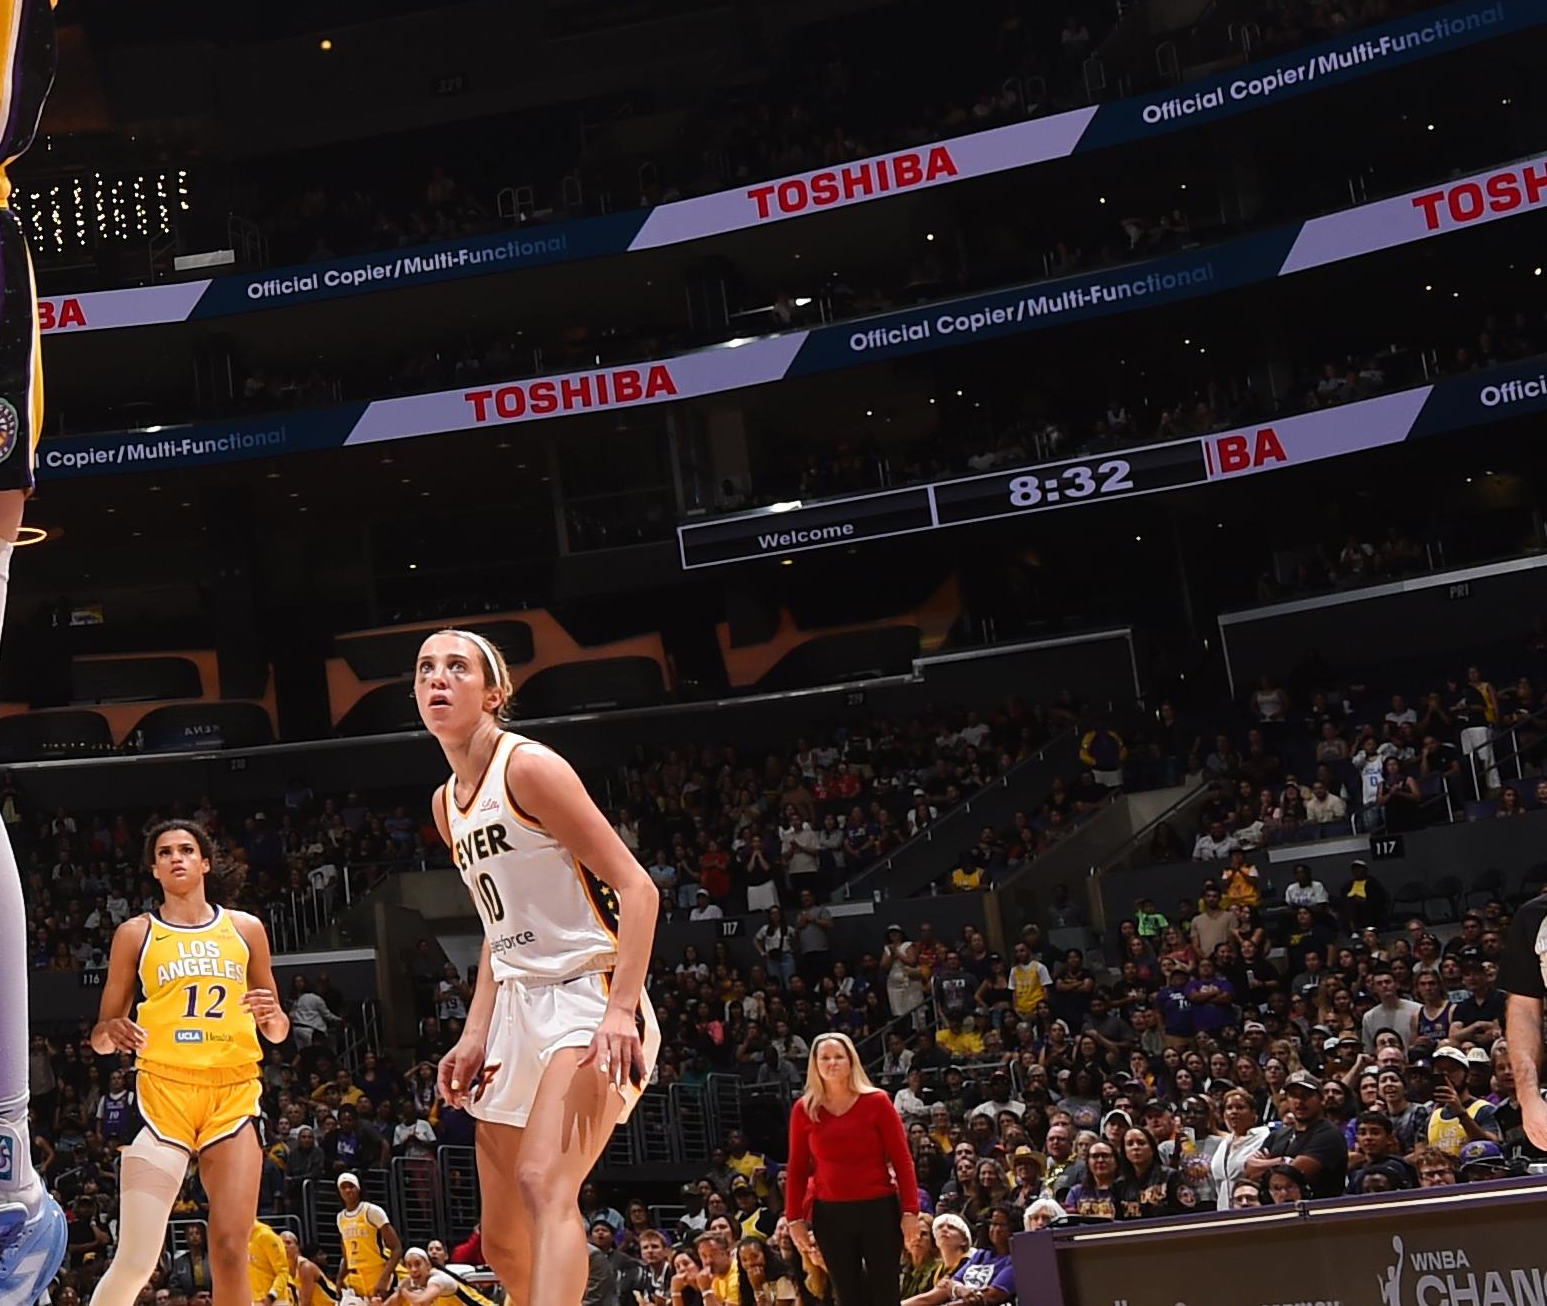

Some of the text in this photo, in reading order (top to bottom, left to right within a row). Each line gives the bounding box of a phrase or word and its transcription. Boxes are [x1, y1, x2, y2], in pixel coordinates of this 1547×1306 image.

[1141, 2, 1506, 126] Official Copier/Multi-Functional
[747, 146, 960, 219] TOSHIBA
[246, 232, 568, 301] Official Copier/Multi-Functional
[848, 262, 1216, 354] Official Copier/Multi-Functional
[464, 365, 678, 423] TOSHIBA
[46, 425, 288, 471] Copier/Multi-Functional
[757, 459, 1135, 551] Welcome 8:32
[1375, 840, 1397, 856] 117
[475, 872, 506, 925] 10
[156, 956, 246, 987] ANGELES
[177, 939, 222, 960] LOS
[181, 983, 229, 1020] 12
[175, 1031, 202, 1043] UCLA
[1409, 1250, 1471, 1271] WNBA
[1415, 1270, 1547, 1306] CHAN
